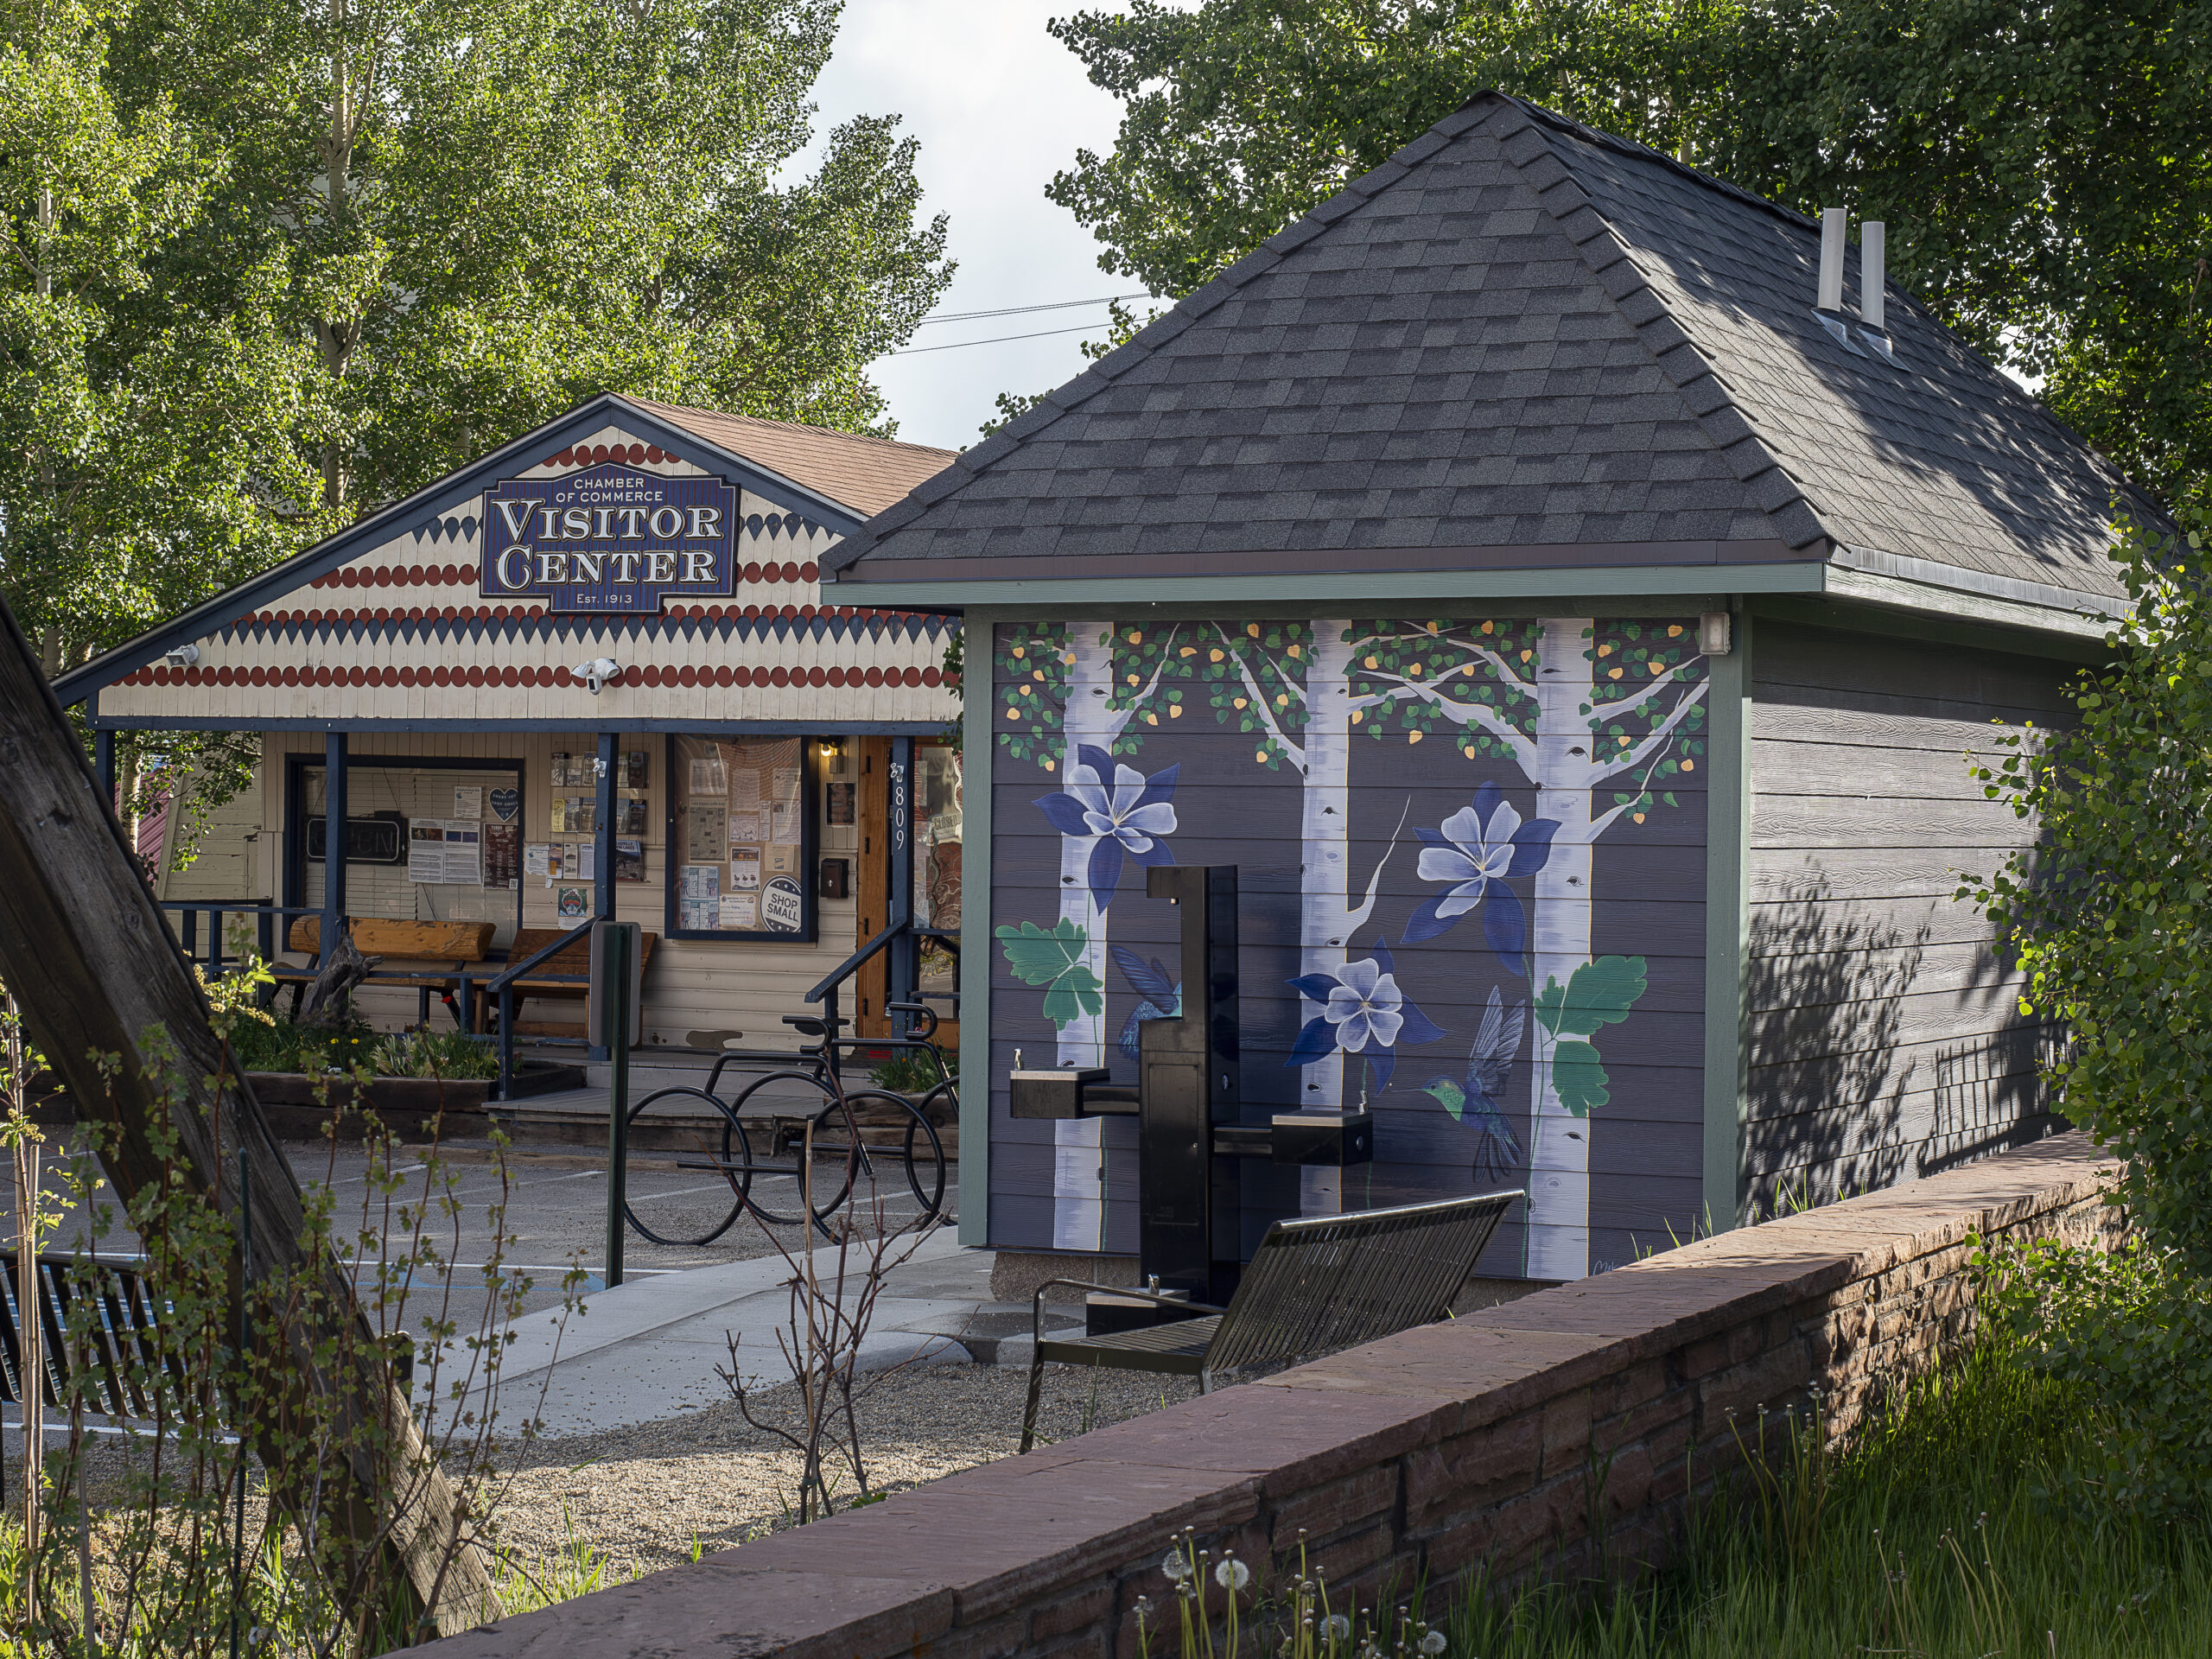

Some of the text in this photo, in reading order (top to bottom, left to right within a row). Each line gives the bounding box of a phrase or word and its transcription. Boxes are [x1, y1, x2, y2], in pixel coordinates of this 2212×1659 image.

[574, 478, 644, 489] CHAMBER
[556, 491, 664, 503] OF COMMERCE
[490, 499, 724, 543] VISITOR
[496, 545, 720, 590] CENTER
[605, 594, 632, 604] 1913
[895, 786, 905, 850] 809
[771, 893, 798, 910] SHOP
[766, 903, 798, 922] SMALL
